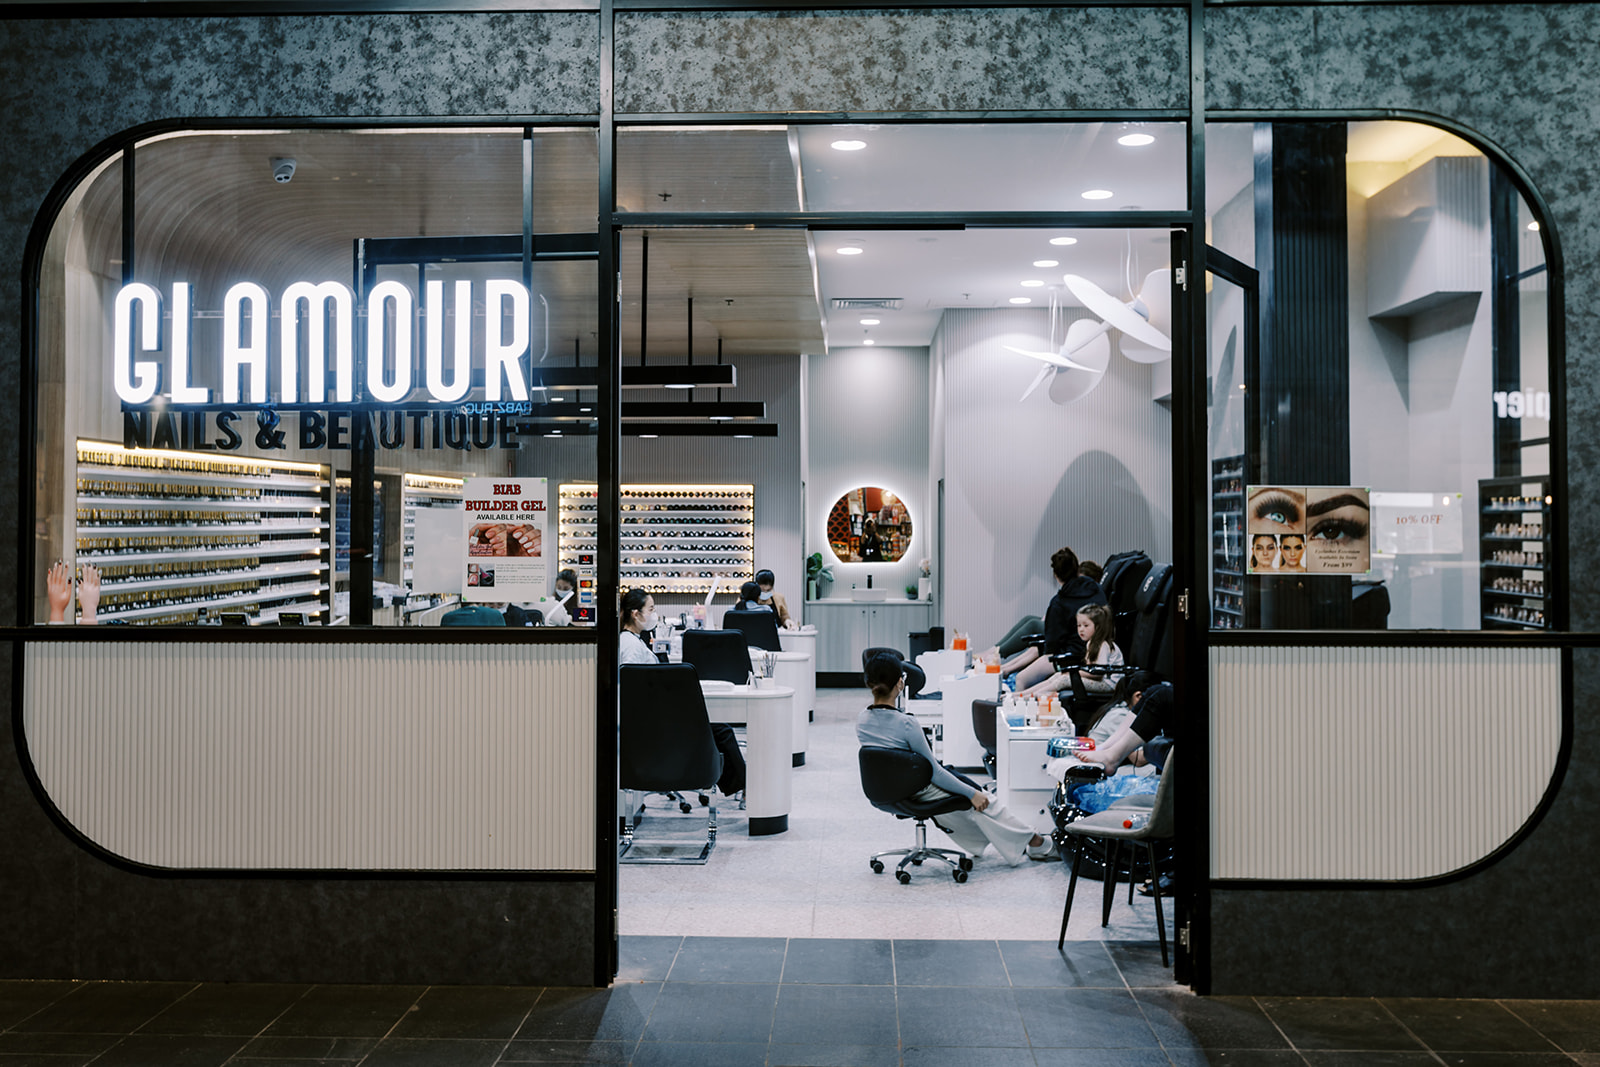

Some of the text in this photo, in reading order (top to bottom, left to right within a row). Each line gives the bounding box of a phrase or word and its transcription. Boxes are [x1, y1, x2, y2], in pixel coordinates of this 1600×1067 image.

[114, 279, 531, 404] GLAMOUR
[123, 409, 521, 451] NAILS & BEAUTIQUE
[493, 484, 521, 495] BIAB
[465, 500, 546, 511] BUILDER GEL
[1396, 514, 1443, 525] 10% OFF
